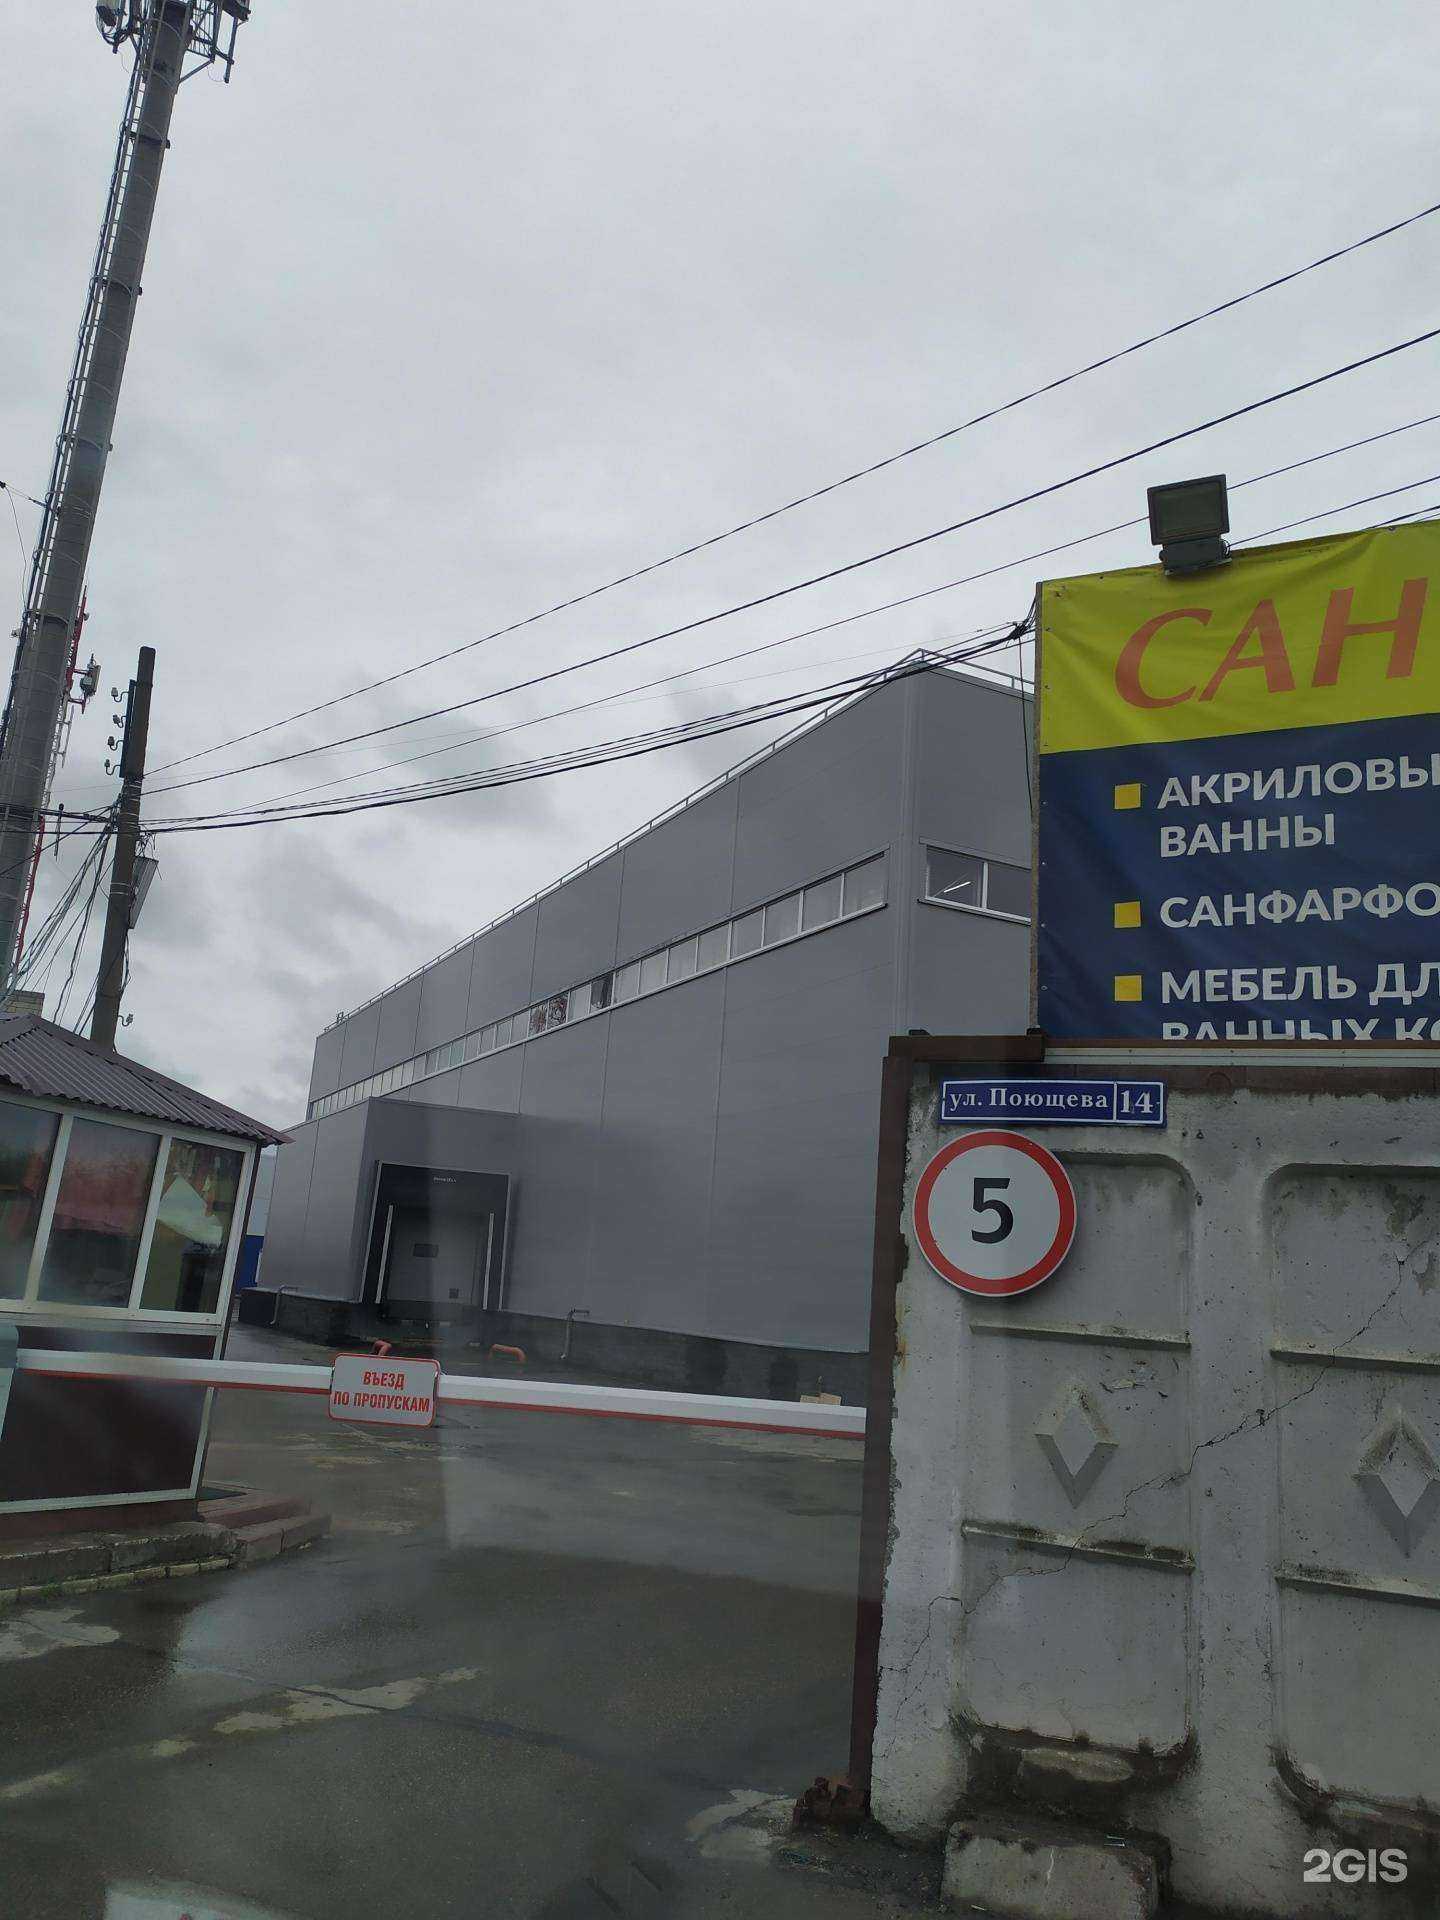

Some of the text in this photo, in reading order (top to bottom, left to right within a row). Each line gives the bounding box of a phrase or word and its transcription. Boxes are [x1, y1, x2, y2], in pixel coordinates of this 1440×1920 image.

[1114, 576, 1429, 709] САН
[1157, 753, 1440, 809] АКРИЛОВЫ
[1160, 813, 1335, 858] ВАННЫ
[1159, 882, 1440, 928] САНФАРФО
[1161, 965, 1357, 1004] МЕБЕЛЬ
[1395, 1017, 1440, 1041] К
[949, 1088, 1154, 1114] ул. Поющева 14
[971, 1177, 1014, 1244] 5
[333, 1391, 430, 1412] ПО ПРОПУСКАМ
[363, 1371, 405, 1391] ВЪЕЗД
